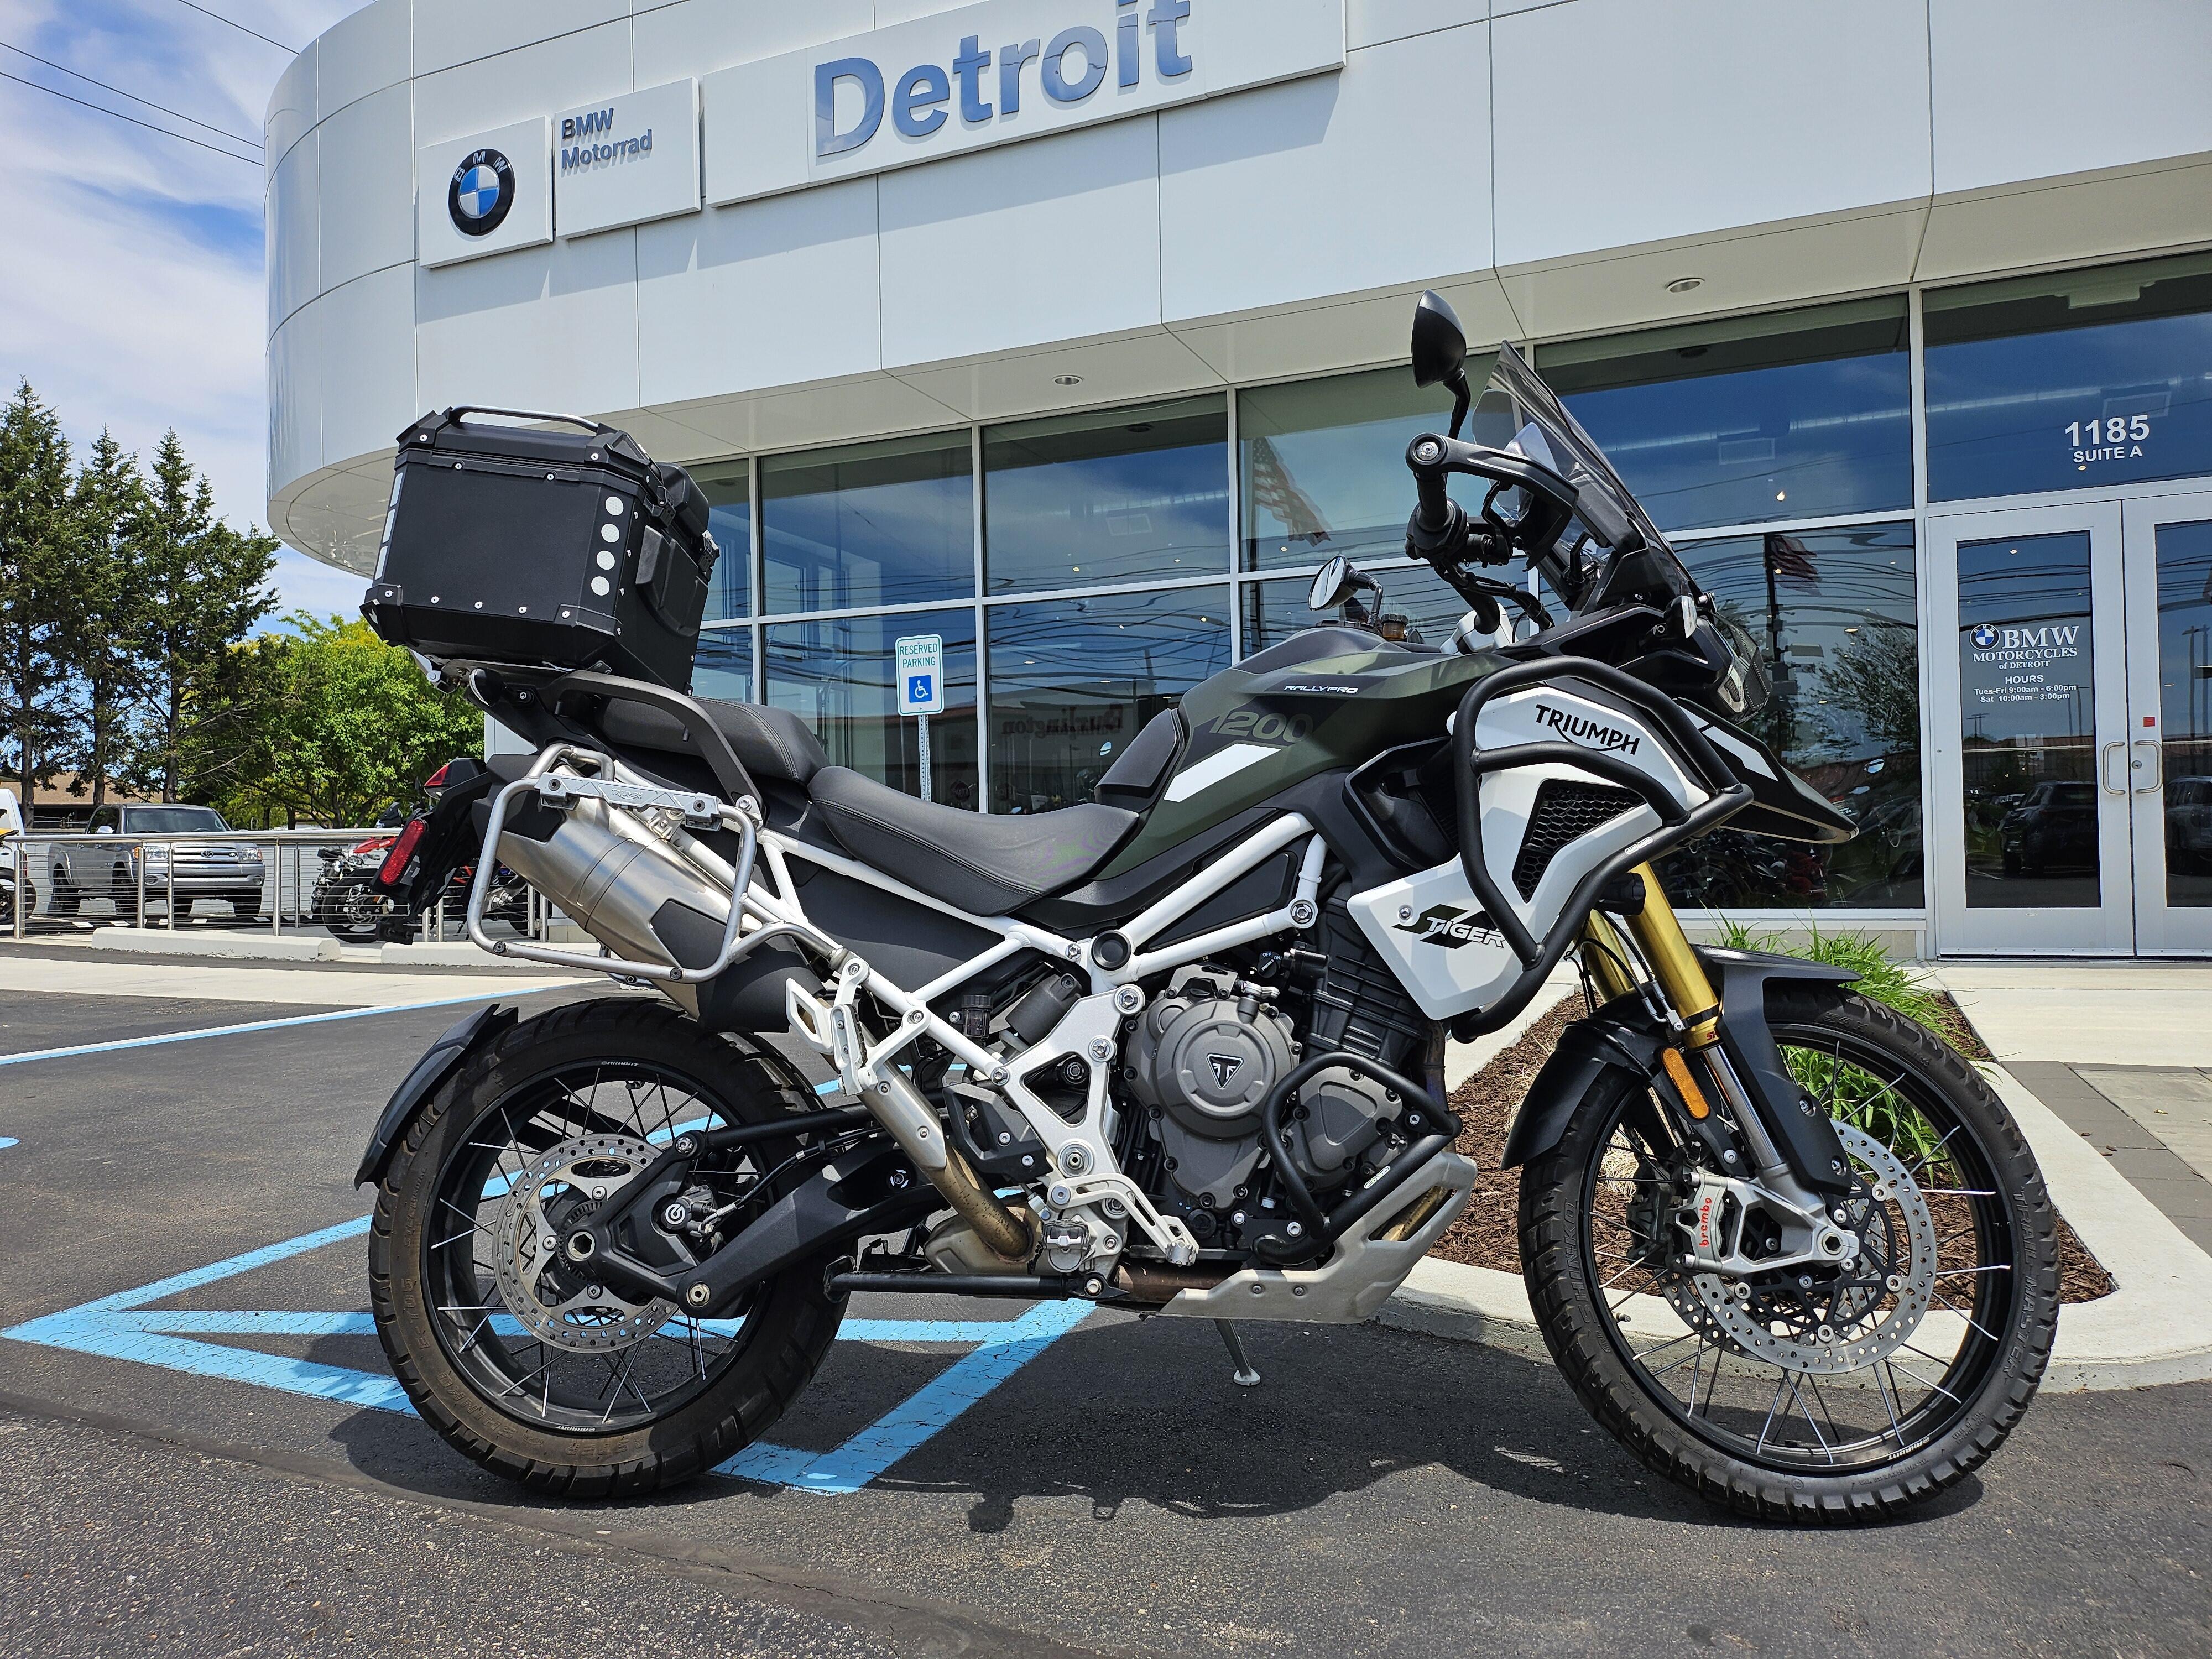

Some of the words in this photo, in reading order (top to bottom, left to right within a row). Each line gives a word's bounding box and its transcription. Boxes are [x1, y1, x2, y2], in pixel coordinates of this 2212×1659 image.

[815, 0, 1193, 157] Detroit
[561, 108, 614, 139] BMW
[562, 128, 653, 170] Motorrad
[453, 150, 508, 182] BMW
[2065, 415, 2150, 447] 1185
[2073, 446, 2125, 463] SUITE
[2129, 445, 2143, 457] A
[900, 643, 937, 655] RESERVED
[2001, 625, 2079, 649] BMW
[902, 656, 936, 668] PARKING
[1973, 647, 2078, 662] MOTORCYCLES
[2010, 660, 2051, 669] DETROIT
[2005, 675, 2044, 684] HOURS
[2046, 684, 2077, 693] 6:00pm
[2039, 692, 2070, 701] 3:00pm
[1209, 711, 1314, 743] 1200
[1535, 703, 1640, 755] TRIUMPH
[1426, 916, 1506, 948] TIGER
[1699, 1197, 1712, 1248] brembo
[1564, 1198, 1595, 1325] SHINKO
[2003, 1276, 2038, 1379] MASTER
